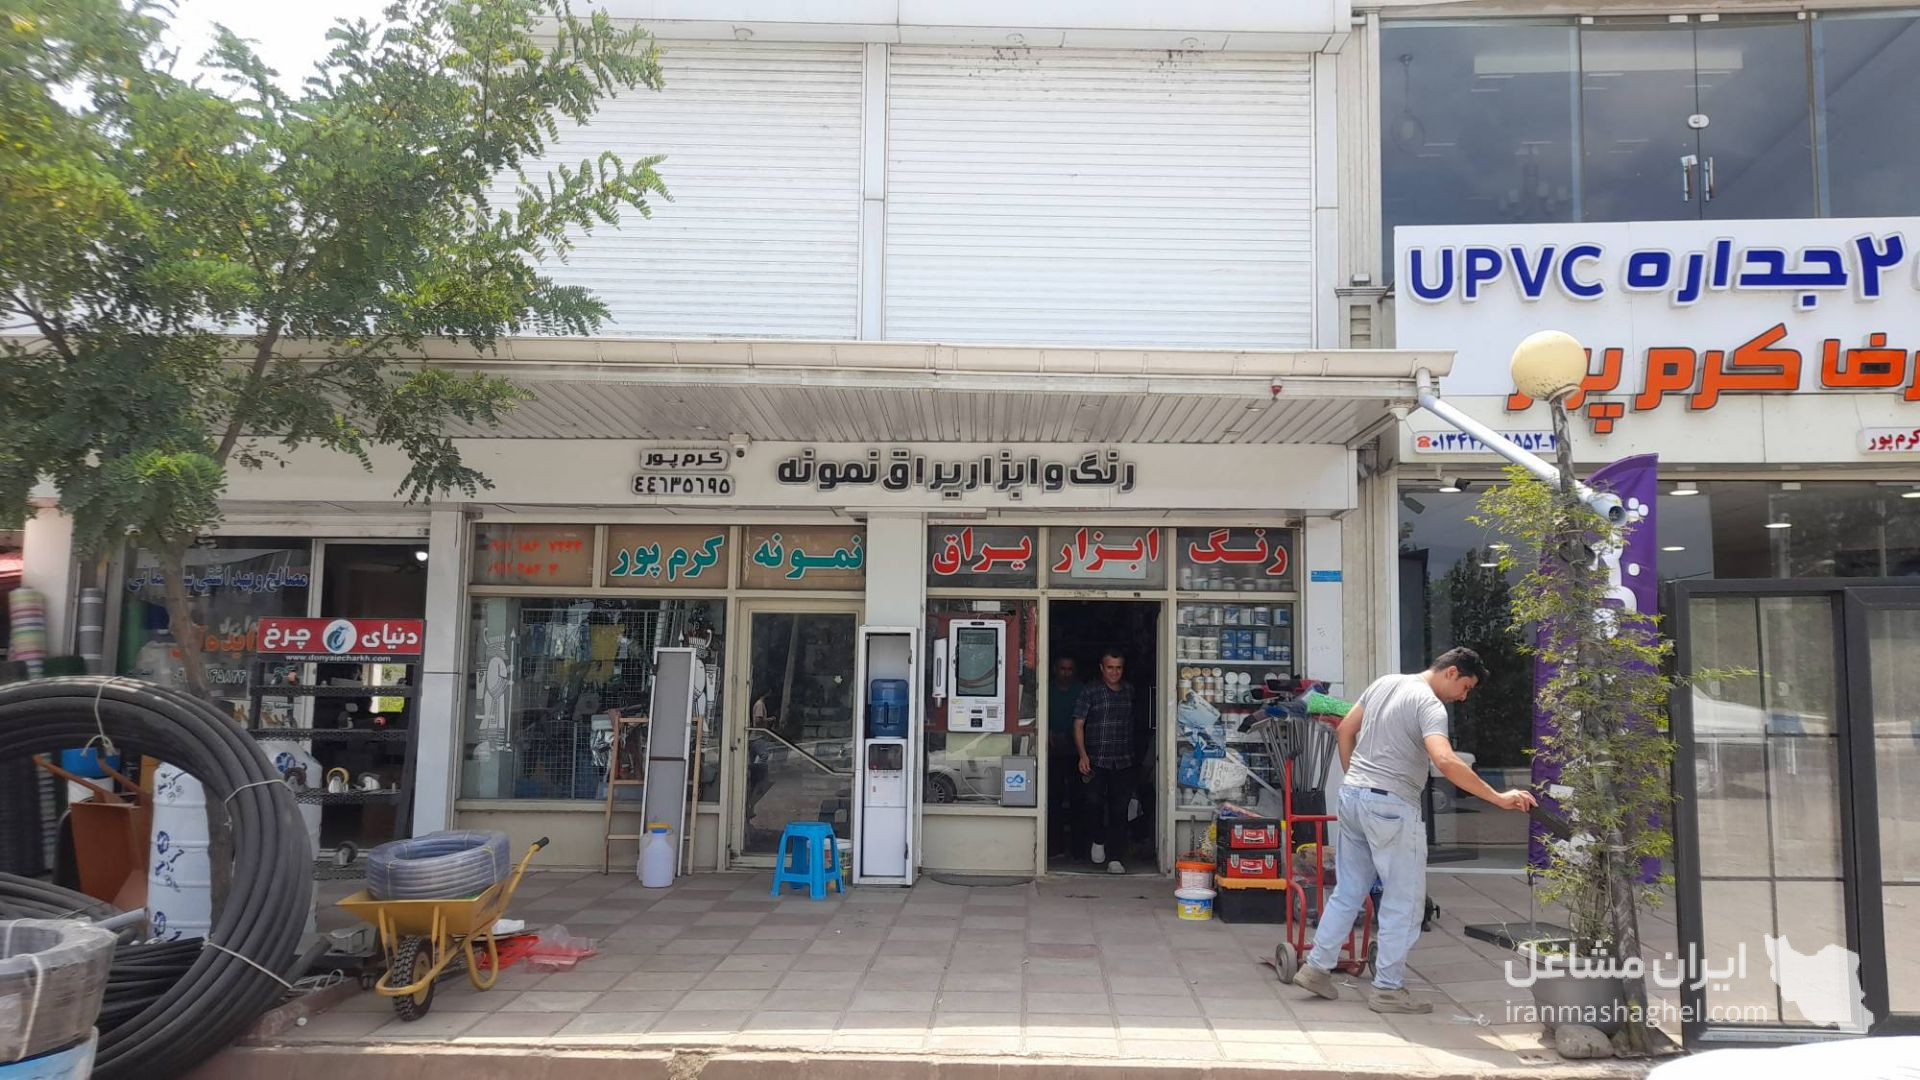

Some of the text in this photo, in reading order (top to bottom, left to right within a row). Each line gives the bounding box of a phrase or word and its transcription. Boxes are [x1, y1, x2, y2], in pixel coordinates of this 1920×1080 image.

[1410, 245, 1602, 299] UPVC
[778, 451, 878, 490] نمونه
[609, 534, 725, 582] کرم پور
[752, 532, 864, 580] نمونه
[932, 526, 1033, 575] یراق
[1052, 527, 1160, 573] ابزار
[1188, 527, 1289, 575] رنگ
[263, 622, 311, 650] چرخ
[361, 623, 418, 650] دنیای
